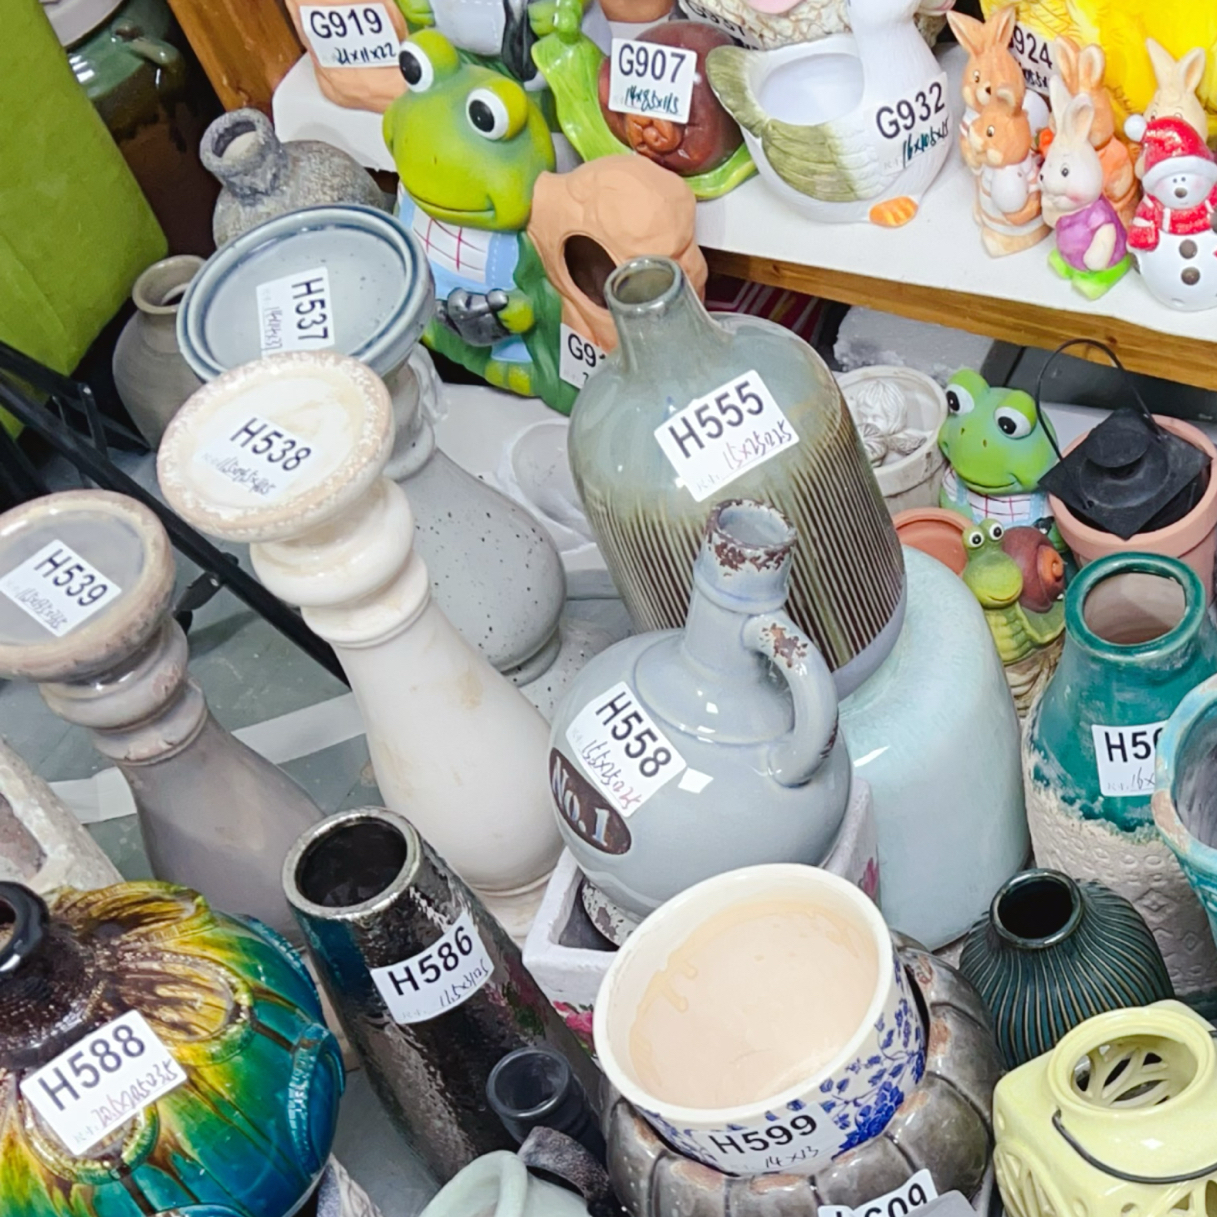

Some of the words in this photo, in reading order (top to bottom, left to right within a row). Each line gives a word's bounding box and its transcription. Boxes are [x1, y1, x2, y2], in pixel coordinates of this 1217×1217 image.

[310, 11, 382, 38] G919
[618, 45, 686, 82] G907
[876, 82, 946, 139] G932
[291, 278, 328, 342] H537
[567, 334, 606, 365] G9
[230, 418, 312, 471] H538
[668, 381, 764, 458] H555
[34, 549, 108, 607] H539
[596, 692, 672, 777] H558
[389, 925, 474, 996] H586
[39, 1025, 145, 1110] H588
[710, 1115, 817, 1154] H599
